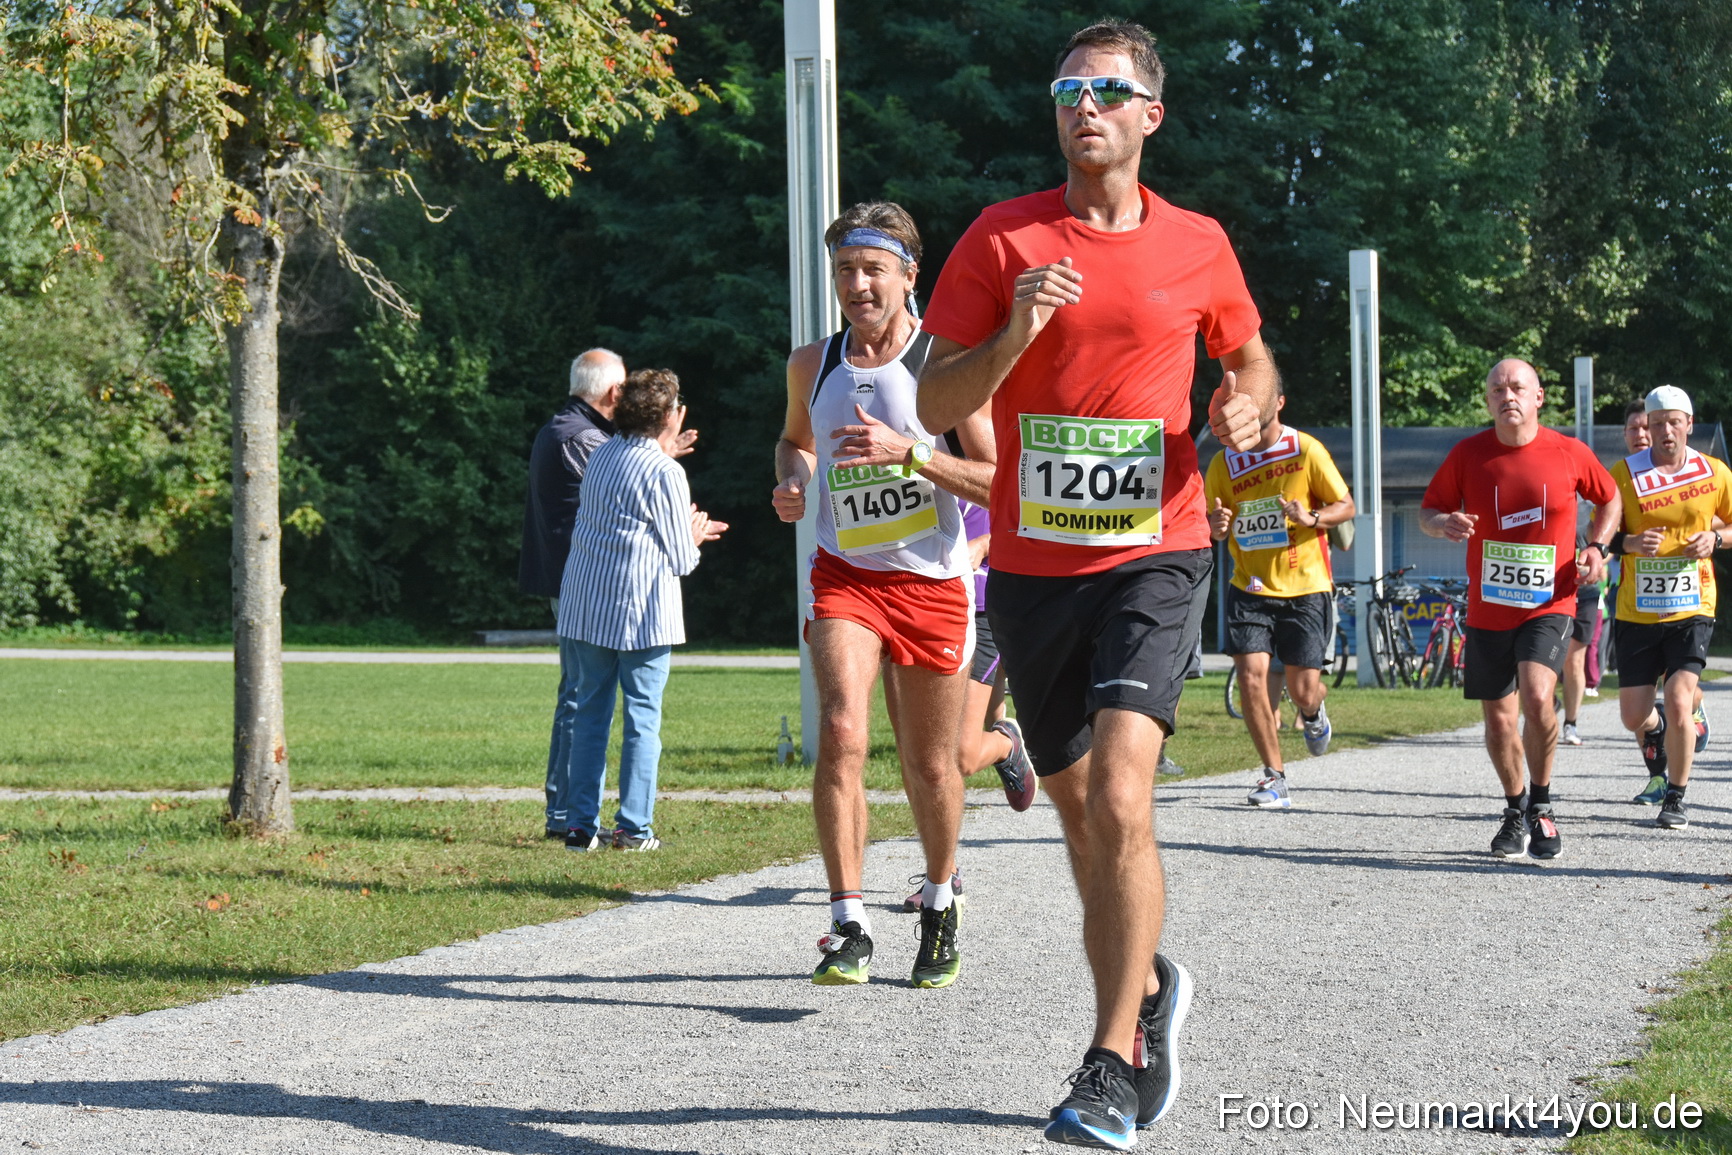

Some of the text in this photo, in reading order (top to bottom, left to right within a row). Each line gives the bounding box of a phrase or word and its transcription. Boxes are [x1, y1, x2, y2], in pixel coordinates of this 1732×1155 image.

[1031, 420, 1150, 452] BOCK
[835, 465, 893, 487] BOC
[1036, 460, 1145, 501] 1204
[1232, 462, 1304, 496] MAX BÖGL
[842, 481, 922, 522] 1405
[1640, 482, 1718, 513] MAX BÖGL
[1042, 510, 1135, 529] DOMINIK
[1237, 514, 1279, 535] 2402
[1512, 513, 1531, 523] DEHN
[1246, 535, 1274, 546] JOVAN
[1489, 544, 1548, 562] BOCK
[1489, 563, 1545, 587] 2565
[1640, 560, 1691, 572] BOCK
[1642, 575, 1692, 594] 2373
[1498, 589, 1534, 600] MARIO
[1642, 595, 1694, 606] CHRISTIAN
[1403, 602, 1445, 620] CAF
